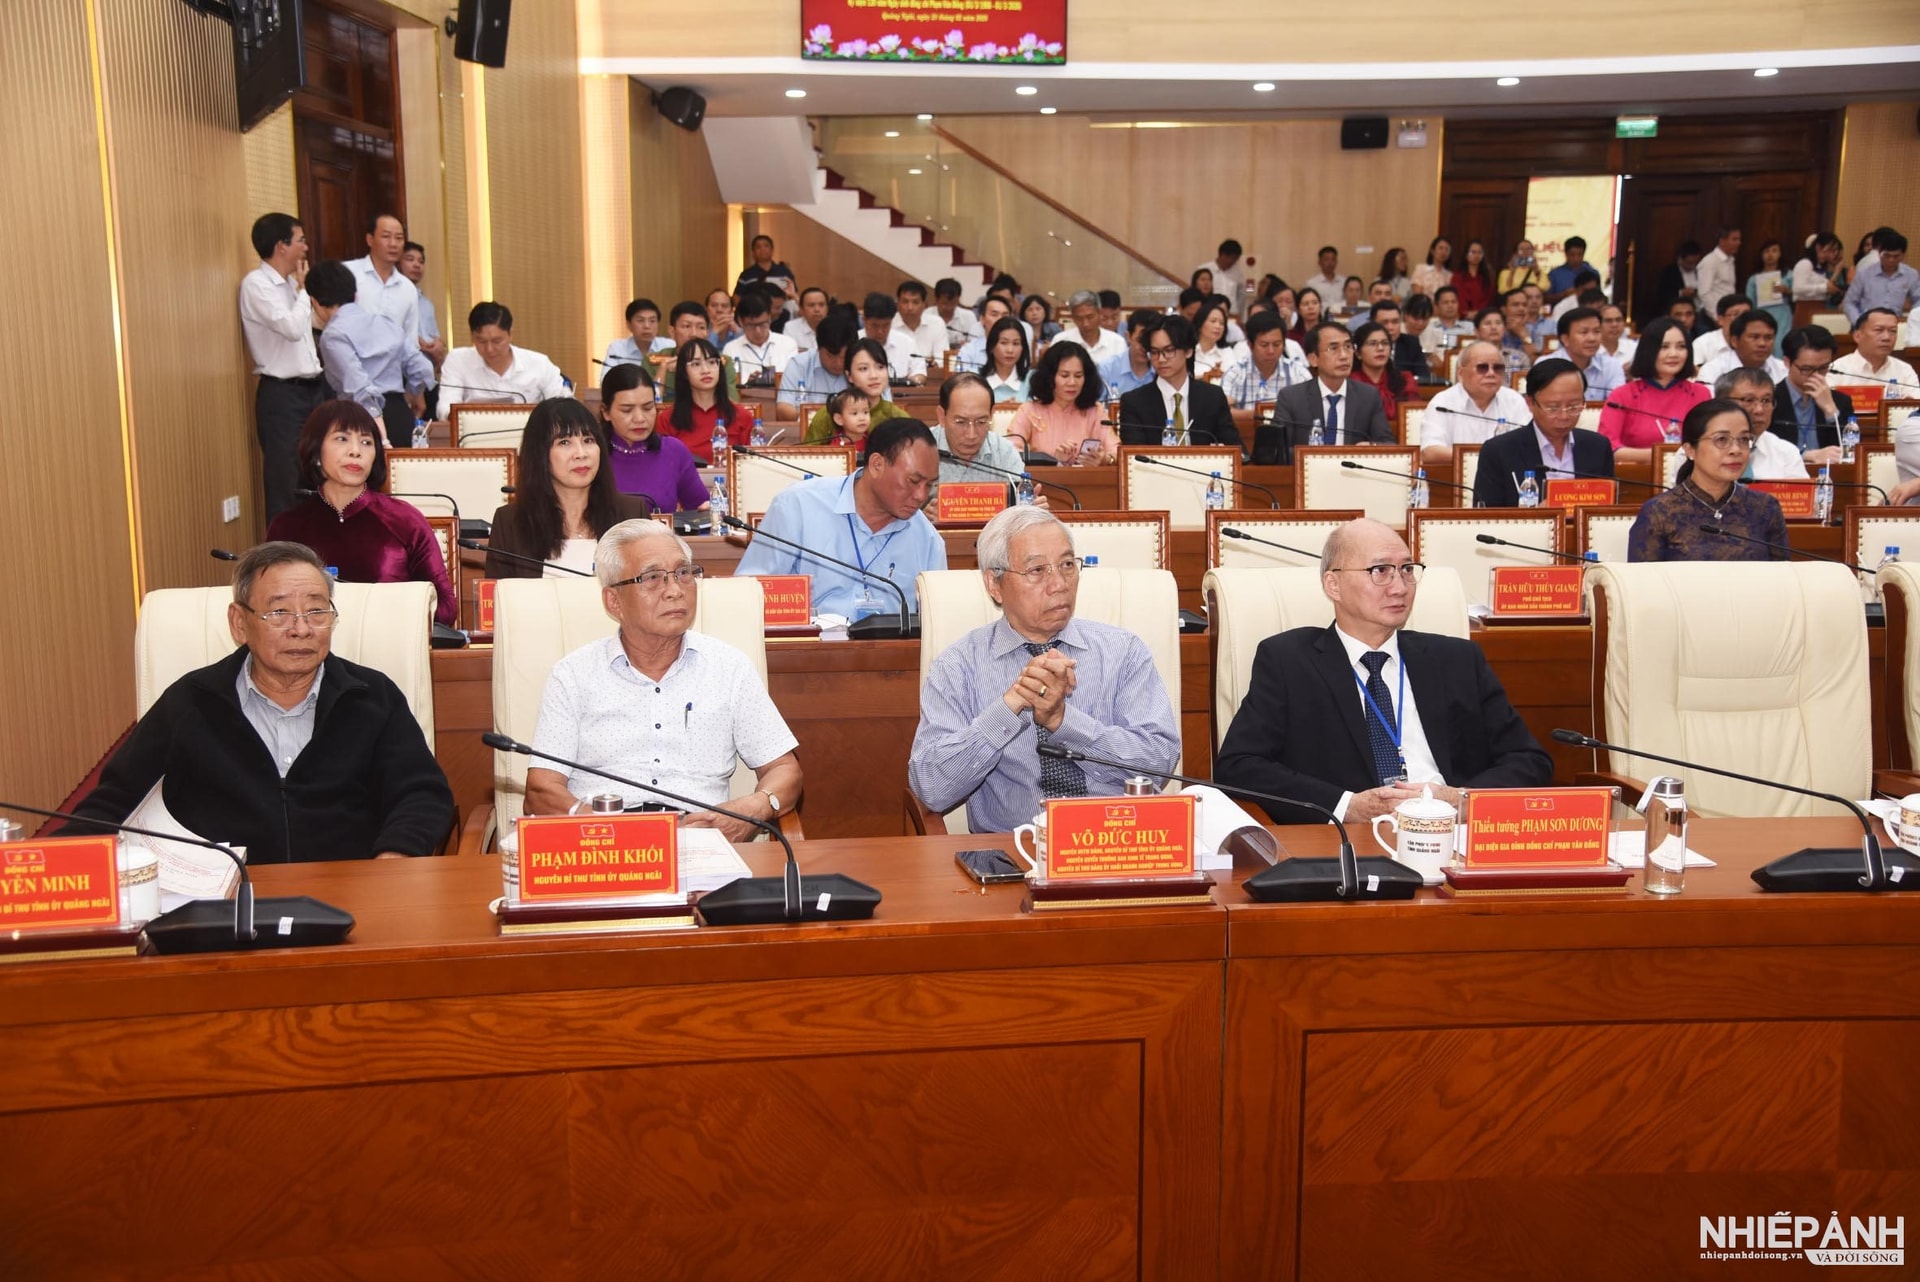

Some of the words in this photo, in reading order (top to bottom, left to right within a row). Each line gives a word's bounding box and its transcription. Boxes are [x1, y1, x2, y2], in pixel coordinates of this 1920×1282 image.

[1554, 583, 1578, 593] GIANG
[1473, 816, 1495, 833] Thiếu
[1497, 820, 1519, 836] tướng
[1521, 818, 1548, 836] PHẠM
[601, 837, 615, 846] CHÍ
[1072, 829, 1095, 846] VÕ
[1098, 827, 1132, 846] ĐỨC
[1136, 829, 1169, 844] HUY
[1499, 842, 1510, 851] GIA
[532, 851, 577, 870] PHẠM
[581, 847, 620, 866] ĐÌNH
[42, 874, 91, 893] MINH
[564, 872, 572, 883] BÍ
[573, 873, 588, 883] THƯ
[607, 871, 618, 882] ỦY
[619, 870, 644, 882] QUẢNG
